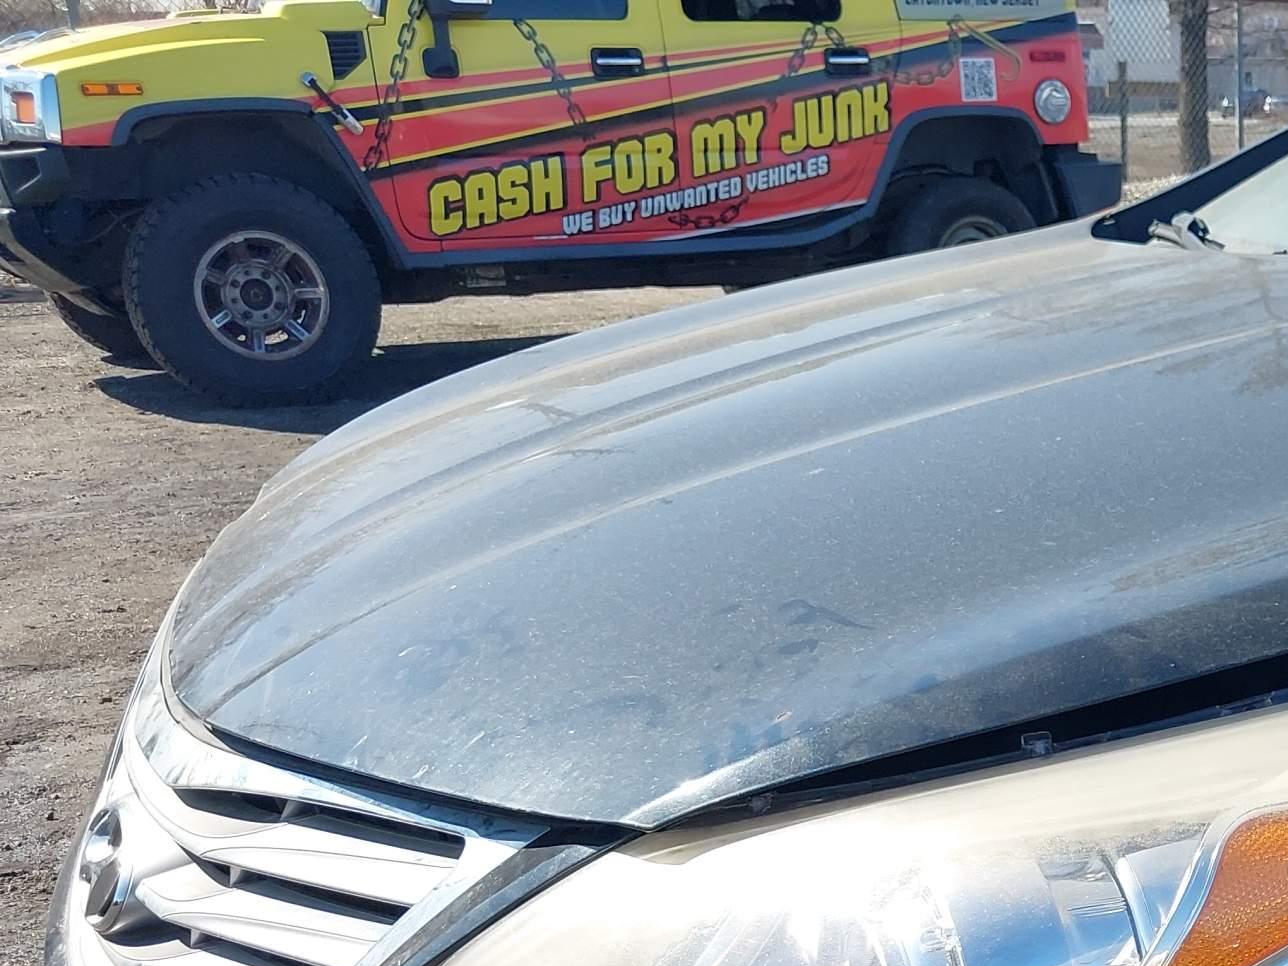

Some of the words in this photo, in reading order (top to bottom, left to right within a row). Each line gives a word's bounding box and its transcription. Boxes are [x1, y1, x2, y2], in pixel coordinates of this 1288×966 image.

[428, 154, 566, 236] CASH
[582, 131, 677, 203] FOR
[691, 110, 765, 178] MY
[780, 81, 890, 154] JUNK
[562, 211, 594, 235] WE
[599, 201, 637, 229] BUY
[640, 176, 742, 218] UNWANTED
[746, 155, 830, 192] VEHICLES
